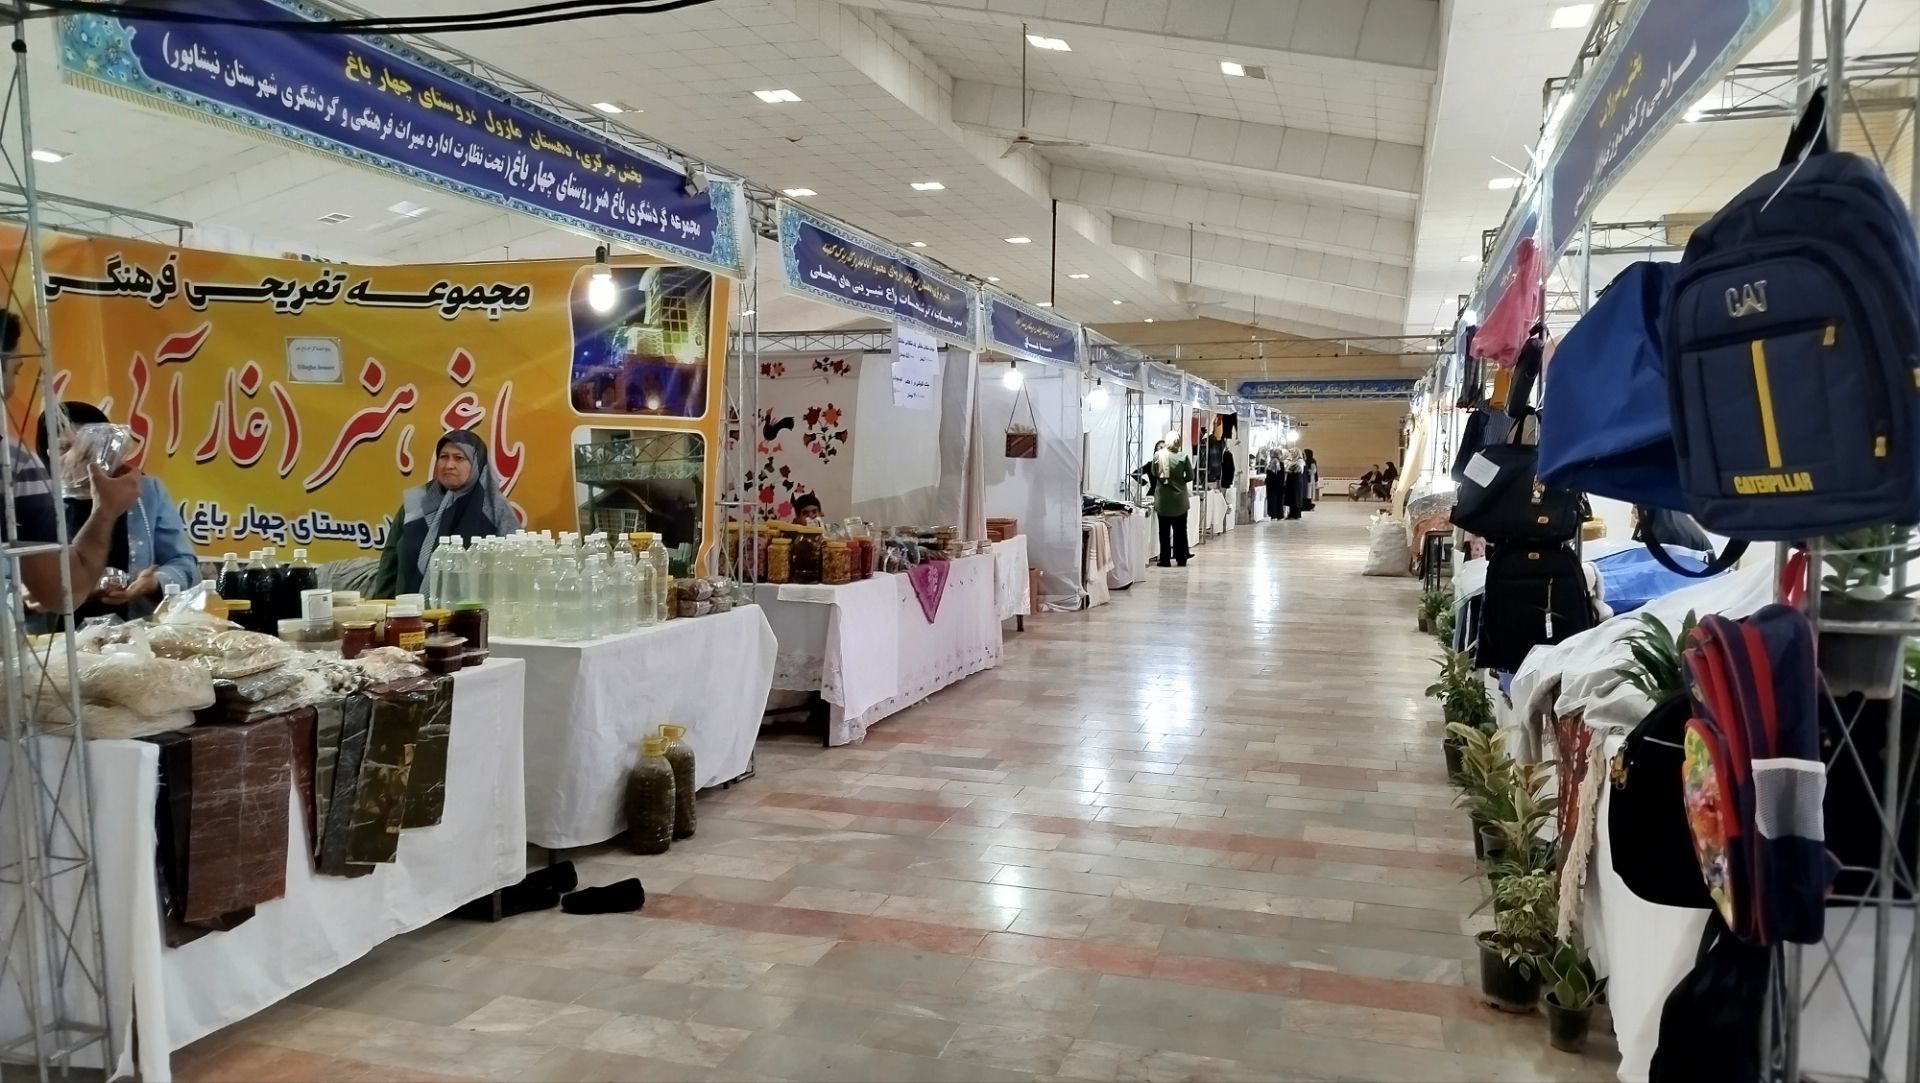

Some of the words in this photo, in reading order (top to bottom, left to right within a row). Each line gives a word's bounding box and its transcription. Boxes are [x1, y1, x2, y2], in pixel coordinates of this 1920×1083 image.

[224, 58, 278, 98] شهرستان
[344, 49, 372, 84] باغ
[378, 67, 413, 103] چهار
[281, 84, 340, 122] گردشگری
[341, 108, 349, 128] و
[350, 107, 394, 141] فرهنگی
[394, 120, 426, 150] میراث
[484, 109, 523, 139] مازول
[427, 131, 454, 158] اداره
[453, 135, 483, 168] نظارت
[529, 129, 574, 158] دهستان
[528, 161, 556, 198] چهار
[556, 172, 593, 208] روستای
[618, 165, 643, 188] بخش
[594, 189, 610, 213] هنر
[610, 185, 626, 219] باغ
[626, 199, 669, 232] گردشگری
[671, 213, 701, 244] مجموعه
[44, 253, 178, 304] فرهنگی
[187, 266, 346, 312] تفریحی
[348, 275, 531, 318] مجموعه
[1725, 280, 1768, 318] CAT
[1733, 471, 1814, 495] CATERPILLAR
[235, 505, 287, 546] چهار
